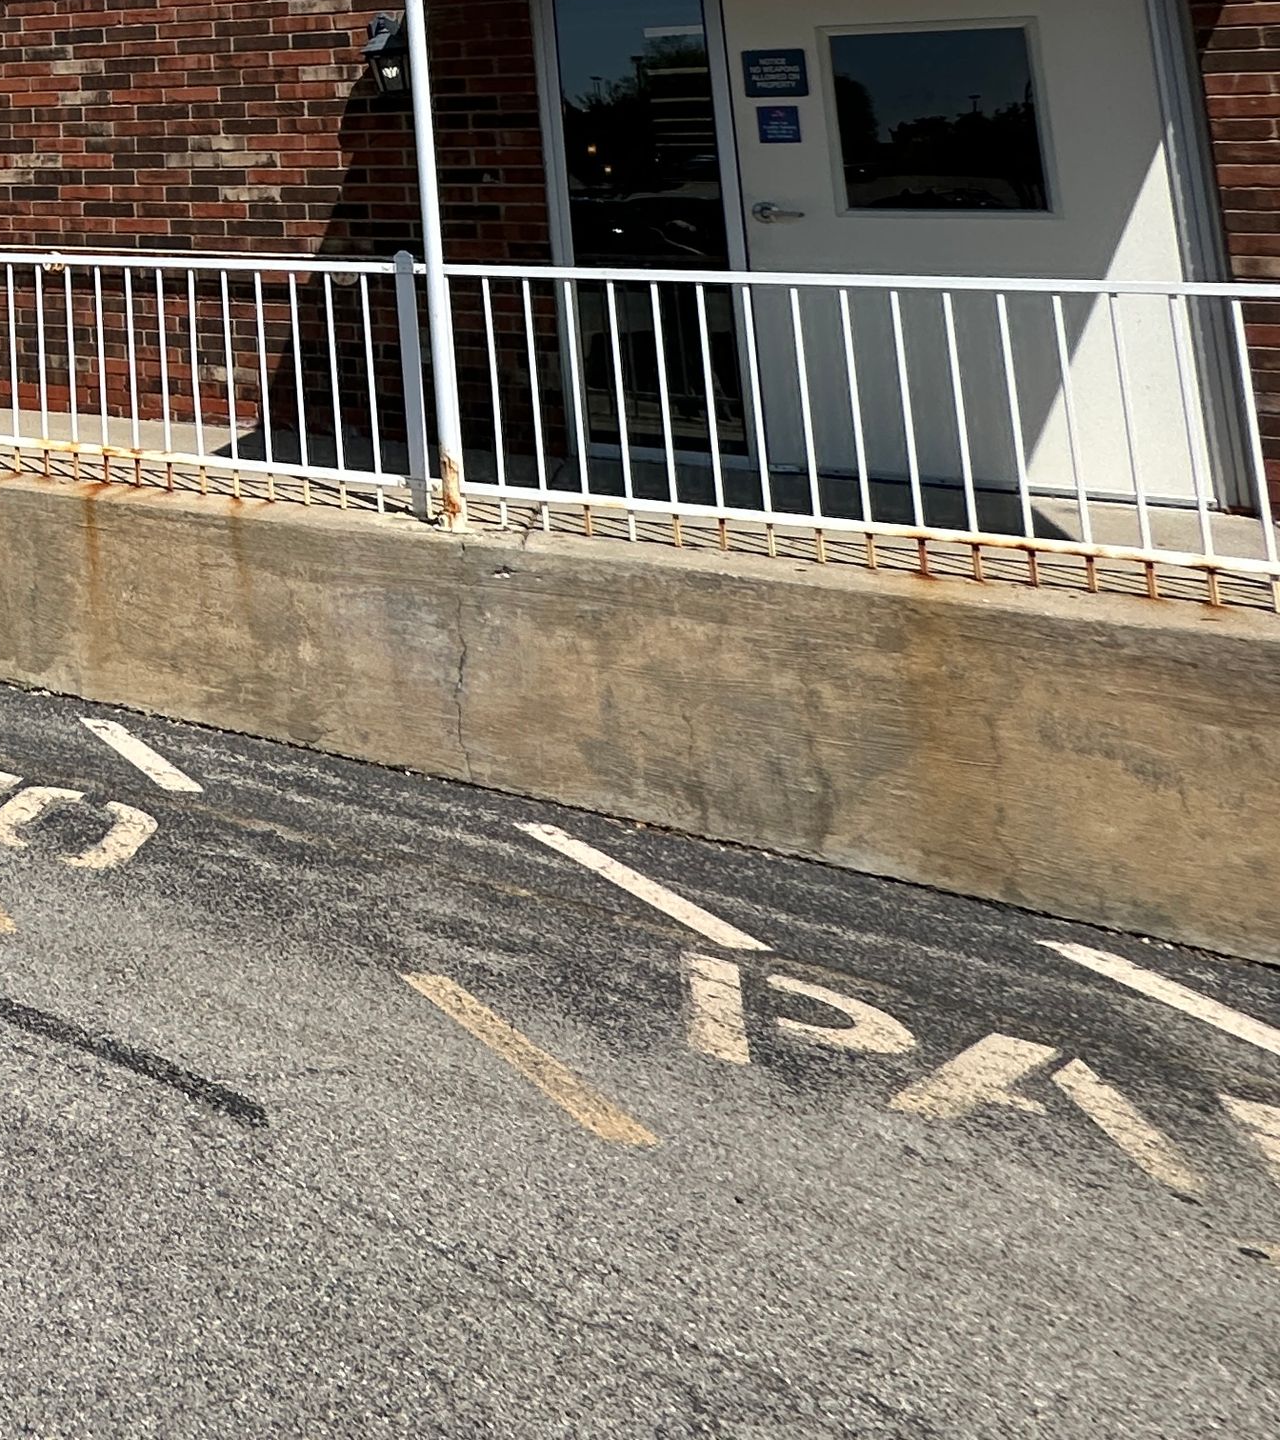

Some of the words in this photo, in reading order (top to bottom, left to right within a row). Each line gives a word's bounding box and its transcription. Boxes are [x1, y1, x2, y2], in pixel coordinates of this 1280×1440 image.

[749, 65, 761, 73] NO
[762, 65, 800, 73] WEAPONS
[751, 73, 787, 81] ALLOWED
[756, 81, 796, 89] PROPERTY
